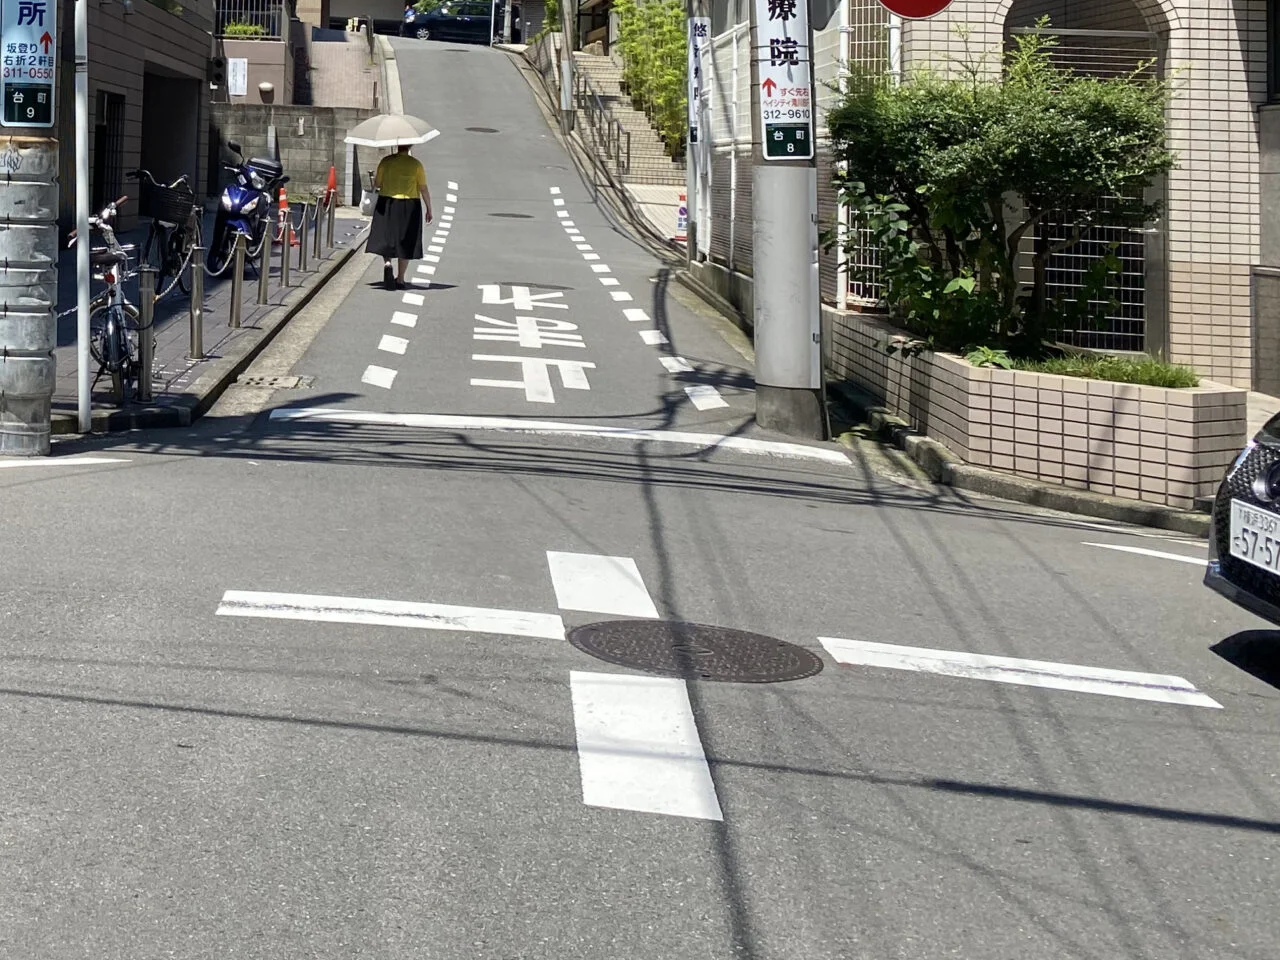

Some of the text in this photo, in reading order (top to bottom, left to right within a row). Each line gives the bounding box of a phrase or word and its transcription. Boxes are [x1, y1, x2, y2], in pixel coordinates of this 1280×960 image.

[7, 43, 38, 54] 坂登り
[4, 67, 54, 79] 311-0550
[26, 106, 35, 118] 9
[763, 109, 810, 120] 312-9610
[787, 142, 795, 153] 8
[1242, 527, 1280, 571] 57-57
